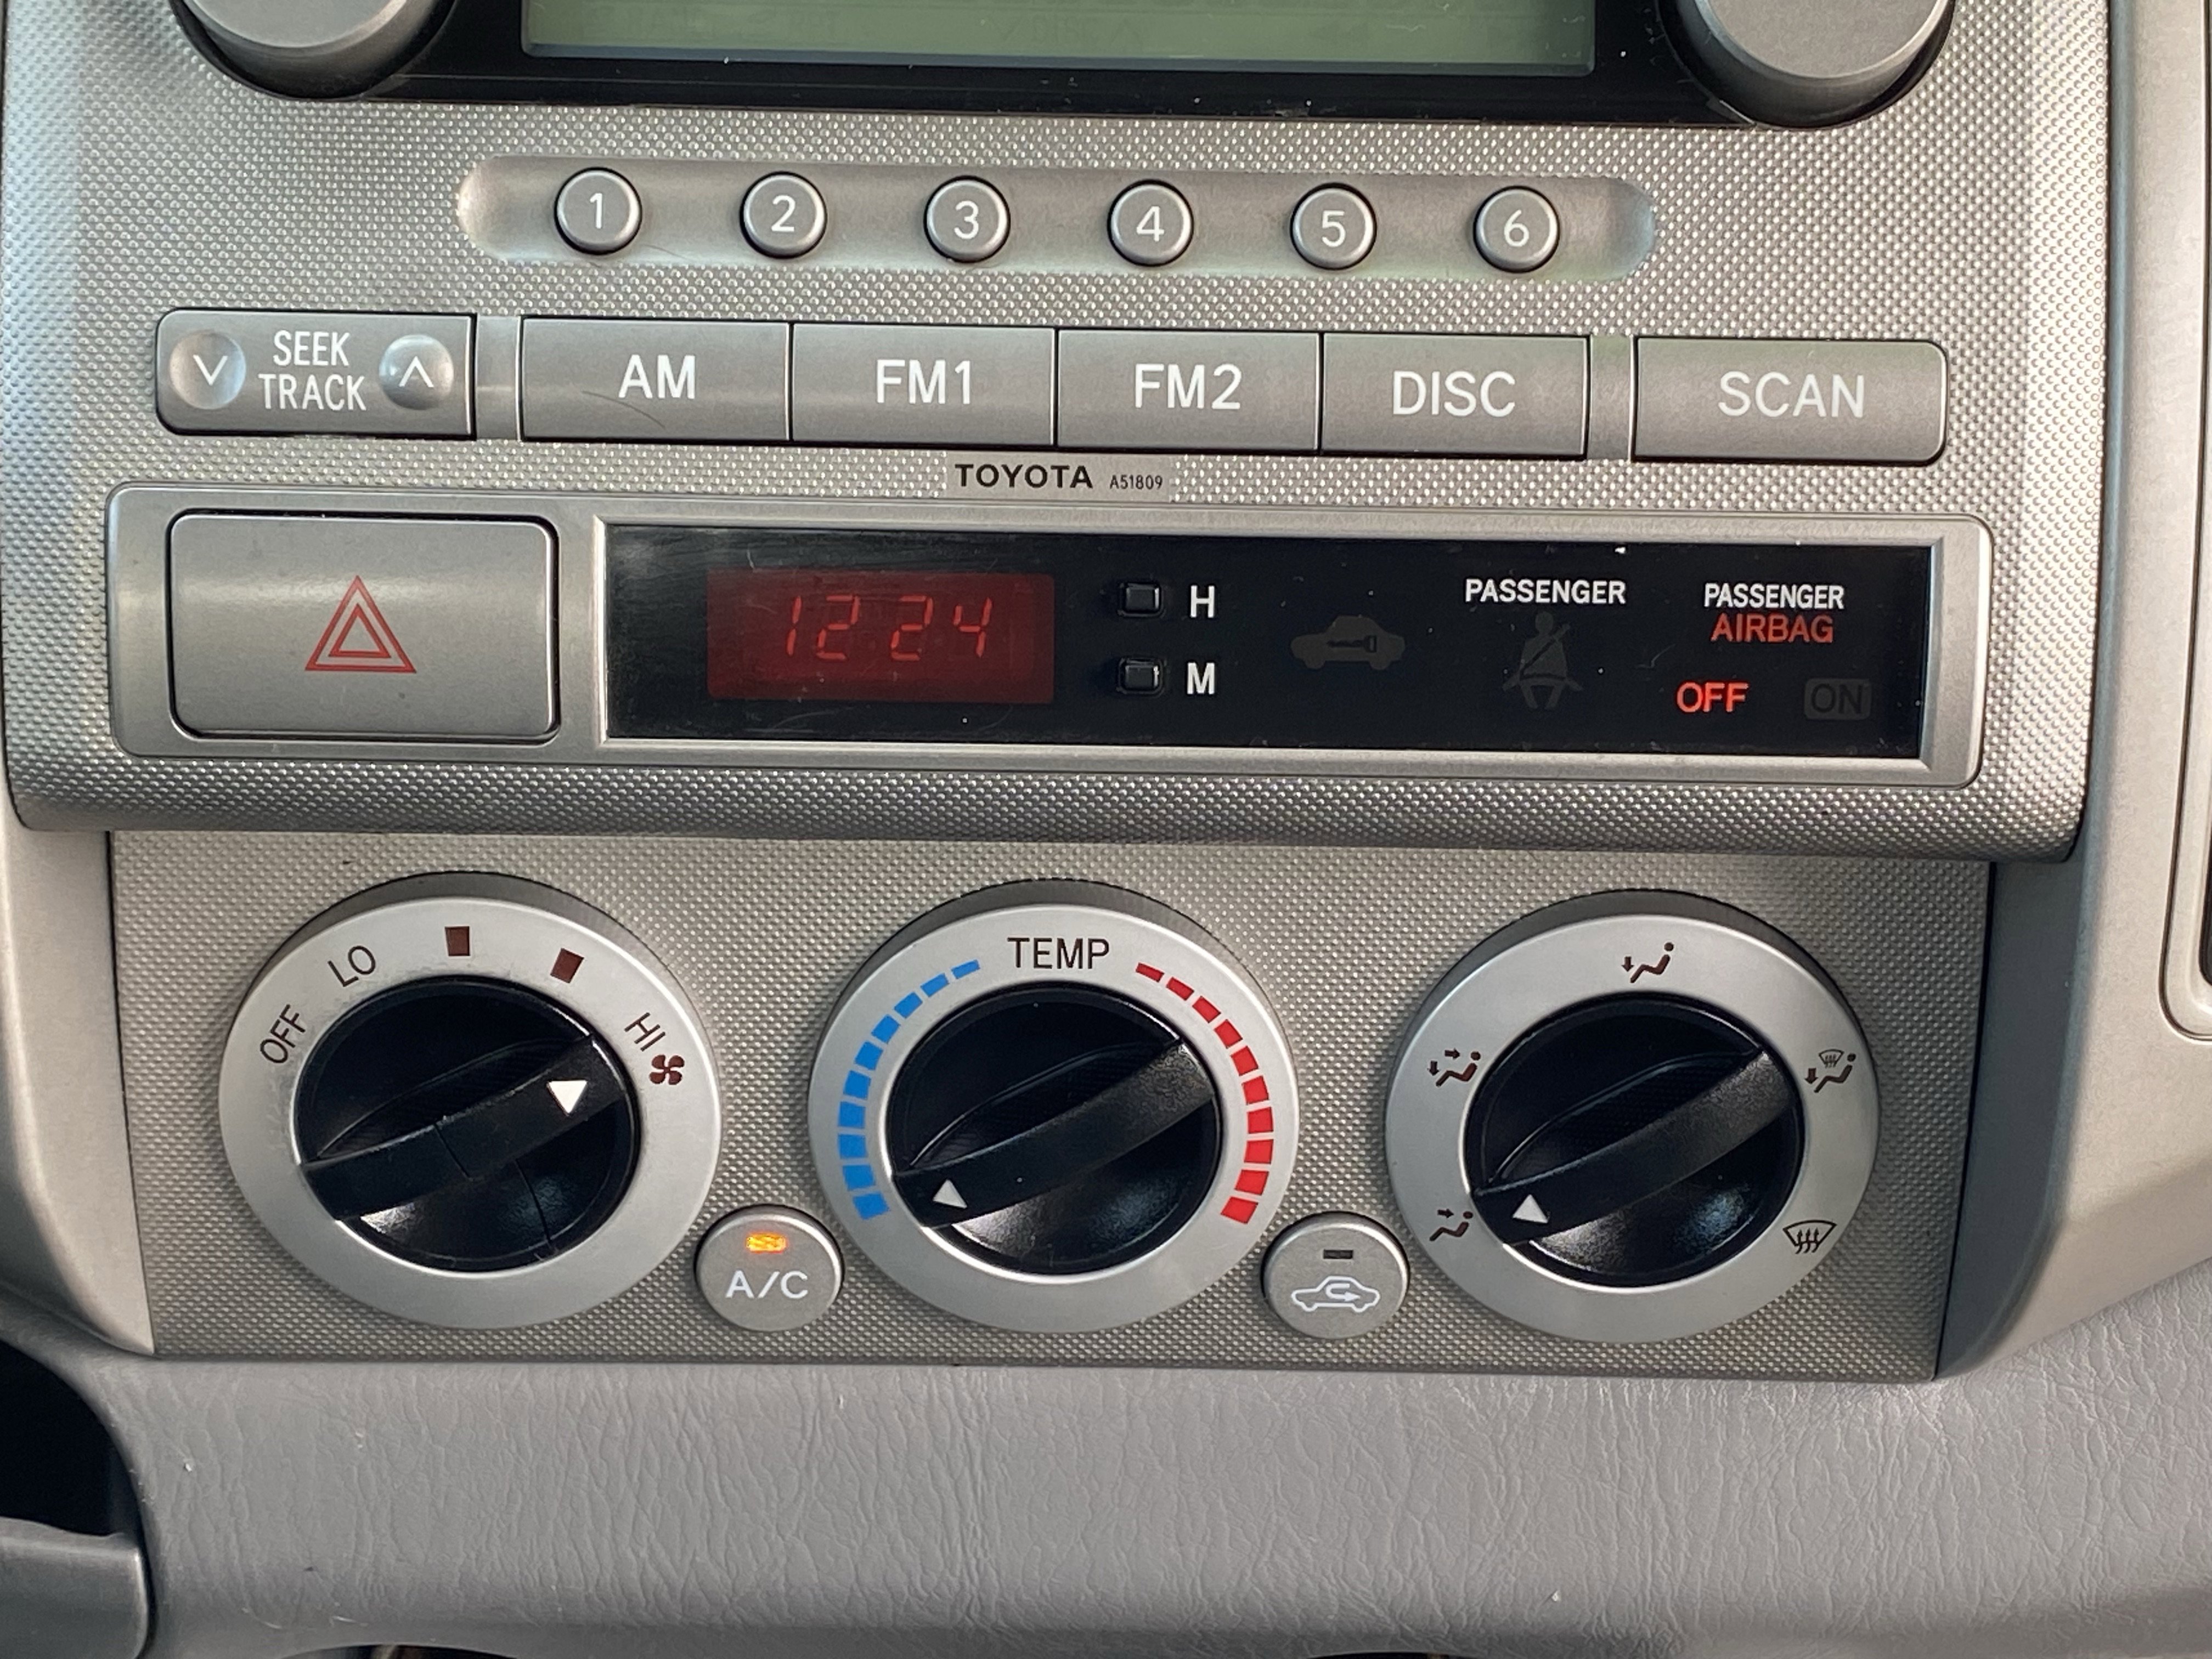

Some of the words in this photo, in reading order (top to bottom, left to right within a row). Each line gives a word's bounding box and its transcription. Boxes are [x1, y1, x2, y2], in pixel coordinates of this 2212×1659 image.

[590, 193, 603, 229] 1
[771, 195, 795, 233] 2
[953, 201, 979, 239] 3
[1136, 206, 1164, 242] 4
[1322, 211, 1345, 247] 5
[1503, 209, 1529, 247] 6
[273, 331, 349, 367] SEEK
[259, 374, 366, 411] TRACK
[617, 355, 696, 399] AM
[877, 359, 971, 404] FM1
[1135, 363, 1242, 409] FM2
[1392, 370, 1516, 417] DISC
[1718, 371, 1863, 417] SCAN
[955, 464, 1093, 488] TOYOTA
[1110, 475, 1163, 490] A51809
[1190, 585, 1215, 618] H
[1465, 579, 1626, 604] PASSENGER
[1705, 583, 1844, 609] PASSENGER
[1711, 614, 1833, 643] AIRBAG
[1187, 662, 1215, 695] M
[1677, 681, 1748, 712] OFF
[1810, 684, 1863, 714] ON
[328, 945, 376, 988] LO
[1007, 937, 1109, 969] TEMP
[259, 1005, 306, 1064] OFF
[624, 1012, 665, 1052] HI
[726, 1270, 808, 1300] A/C
